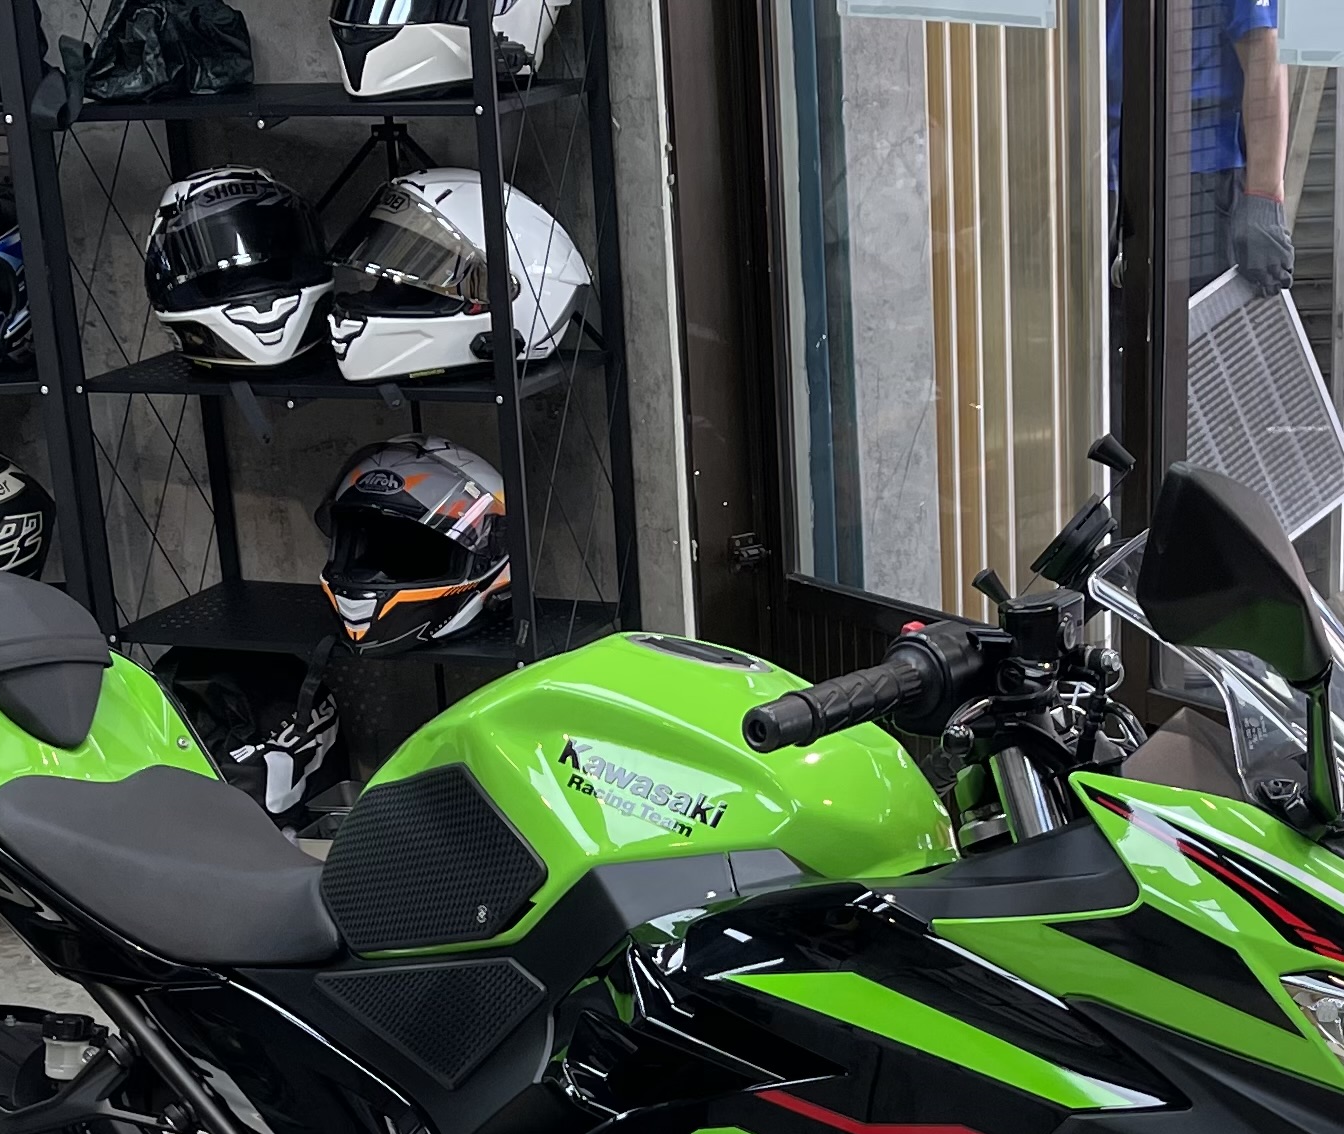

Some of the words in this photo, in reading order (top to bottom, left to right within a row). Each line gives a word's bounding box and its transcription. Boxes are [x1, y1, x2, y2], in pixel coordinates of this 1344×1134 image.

[204, 183, 257, 204] SHOEI
[558, 738, 728, 829] Kawasaki
[567, 773, 637, 816] Racing
[641, 801, 693, 838] Team
